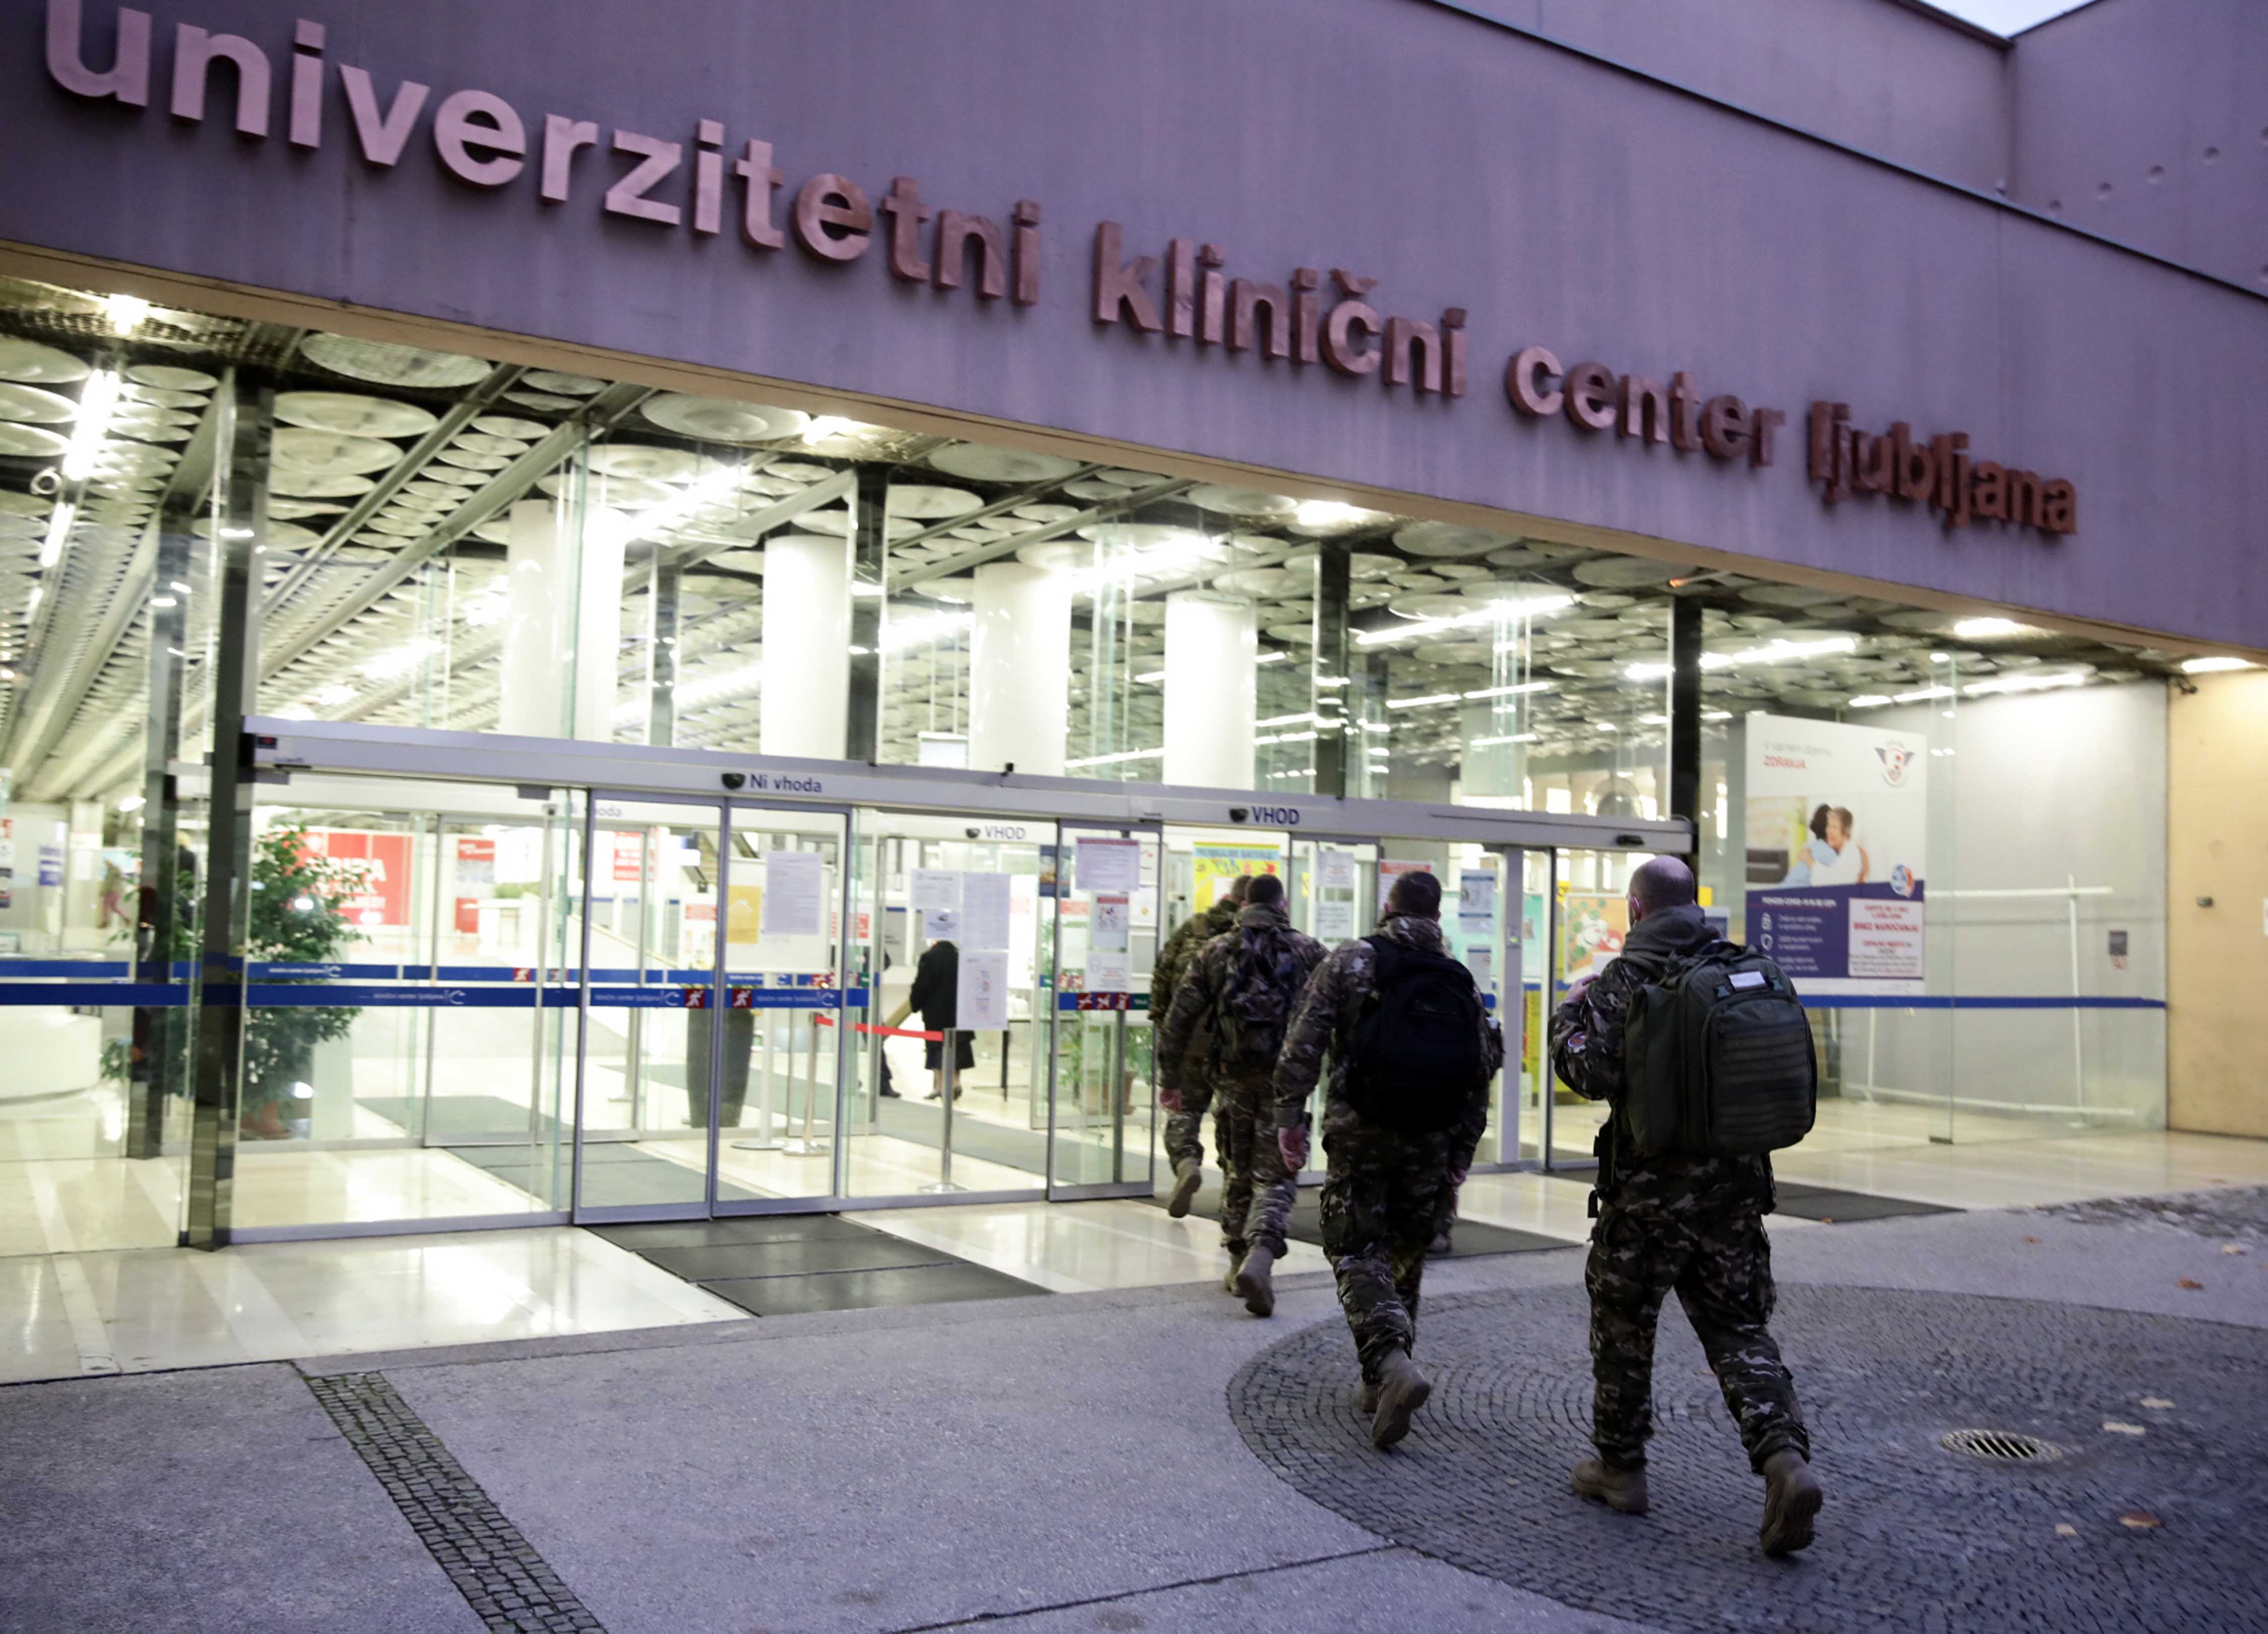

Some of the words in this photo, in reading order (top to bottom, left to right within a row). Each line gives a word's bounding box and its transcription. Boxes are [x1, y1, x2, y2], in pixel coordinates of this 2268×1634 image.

[45, 0, 1040, 305] univerzitetni
[1093, 220, 1468, 397] klinični
[1507, 344, 1785, 468] center
[1806, 400, 2077, 535] ljubljana
[750, 773, 768, 789] Ni
[774, 775, 822, 793] vhoda
[1251, 806, 1300, 825] VHOD
[984, 825, 1026, 840] VHOD
